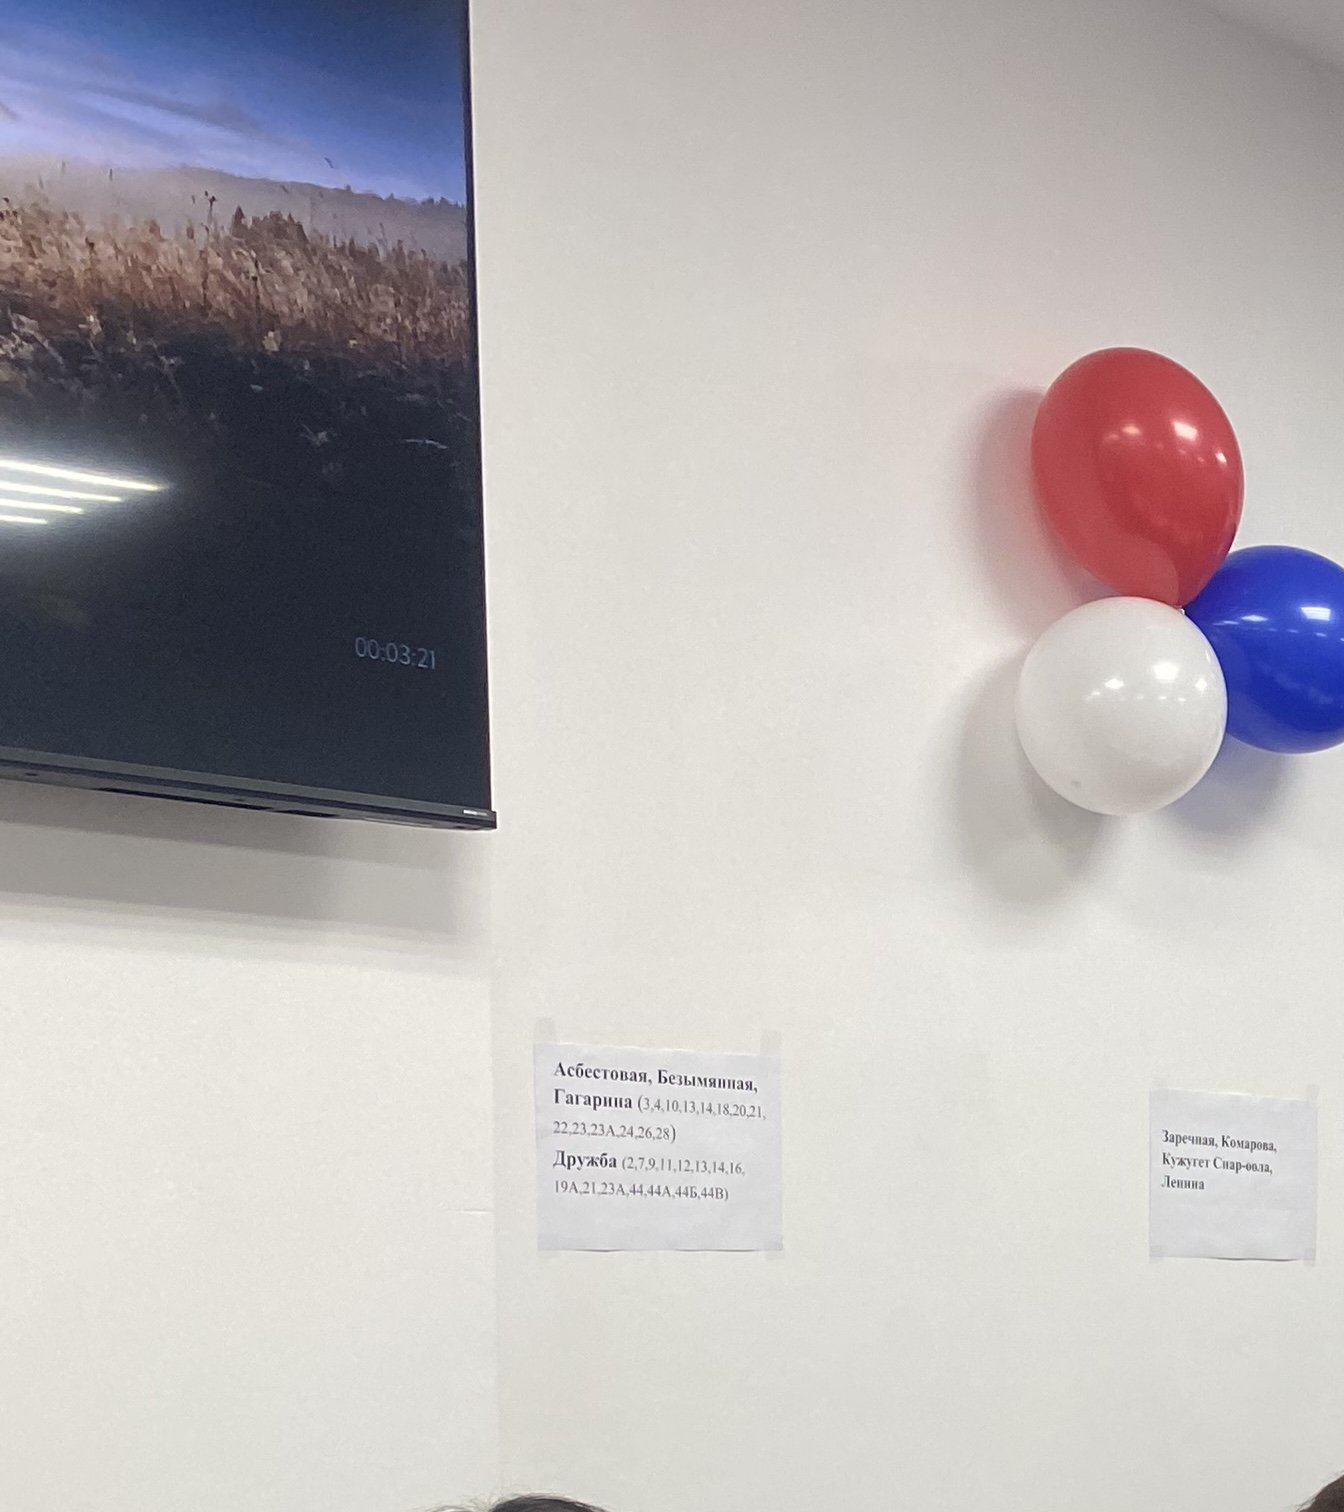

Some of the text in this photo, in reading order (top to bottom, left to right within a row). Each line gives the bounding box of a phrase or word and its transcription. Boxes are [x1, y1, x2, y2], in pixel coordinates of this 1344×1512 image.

[355, 636, 436, 670] 00:03:21
[553, 1062, 758, 1094] Асбестовая, Безымянная,
[553, 1088, 633, 1111] Гагарина
[1161, 1129, 1277, 1155] Заречная, Комарова,
[553, 1150, 618, 1171] Дружба
[1162, 1152, 1210, 1171] Кужугет
[1160, 1175, 1205, 1190] Ленина
